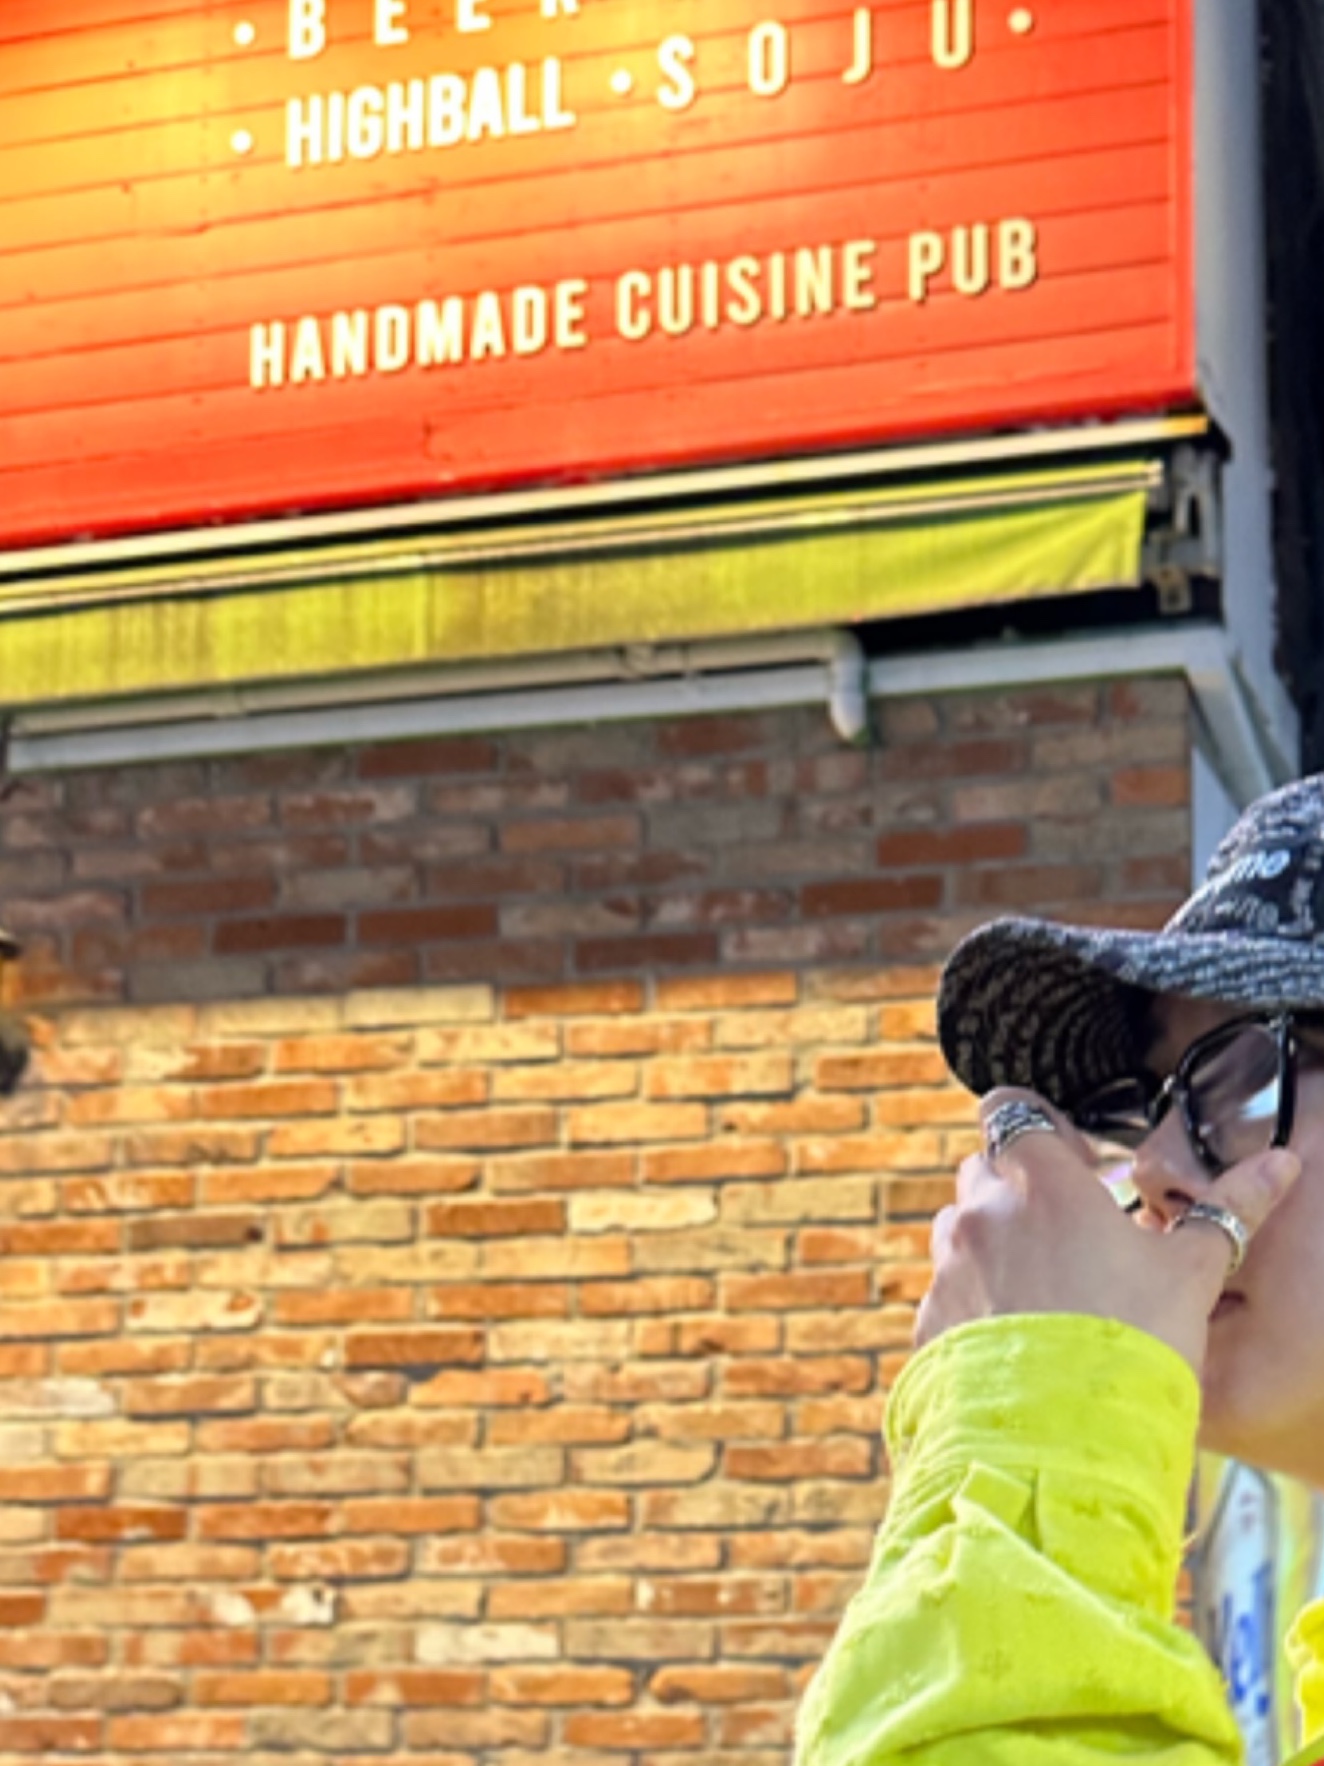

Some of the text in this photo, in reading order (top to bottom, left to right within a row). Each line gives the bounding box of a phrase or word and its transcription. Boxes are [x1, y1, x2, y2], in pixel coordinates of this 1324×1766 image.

[286, 0, 973, 168] HIGHBALL SOJU
[249, 218, 1038, 389] HANDMADE CUISINE PUB
